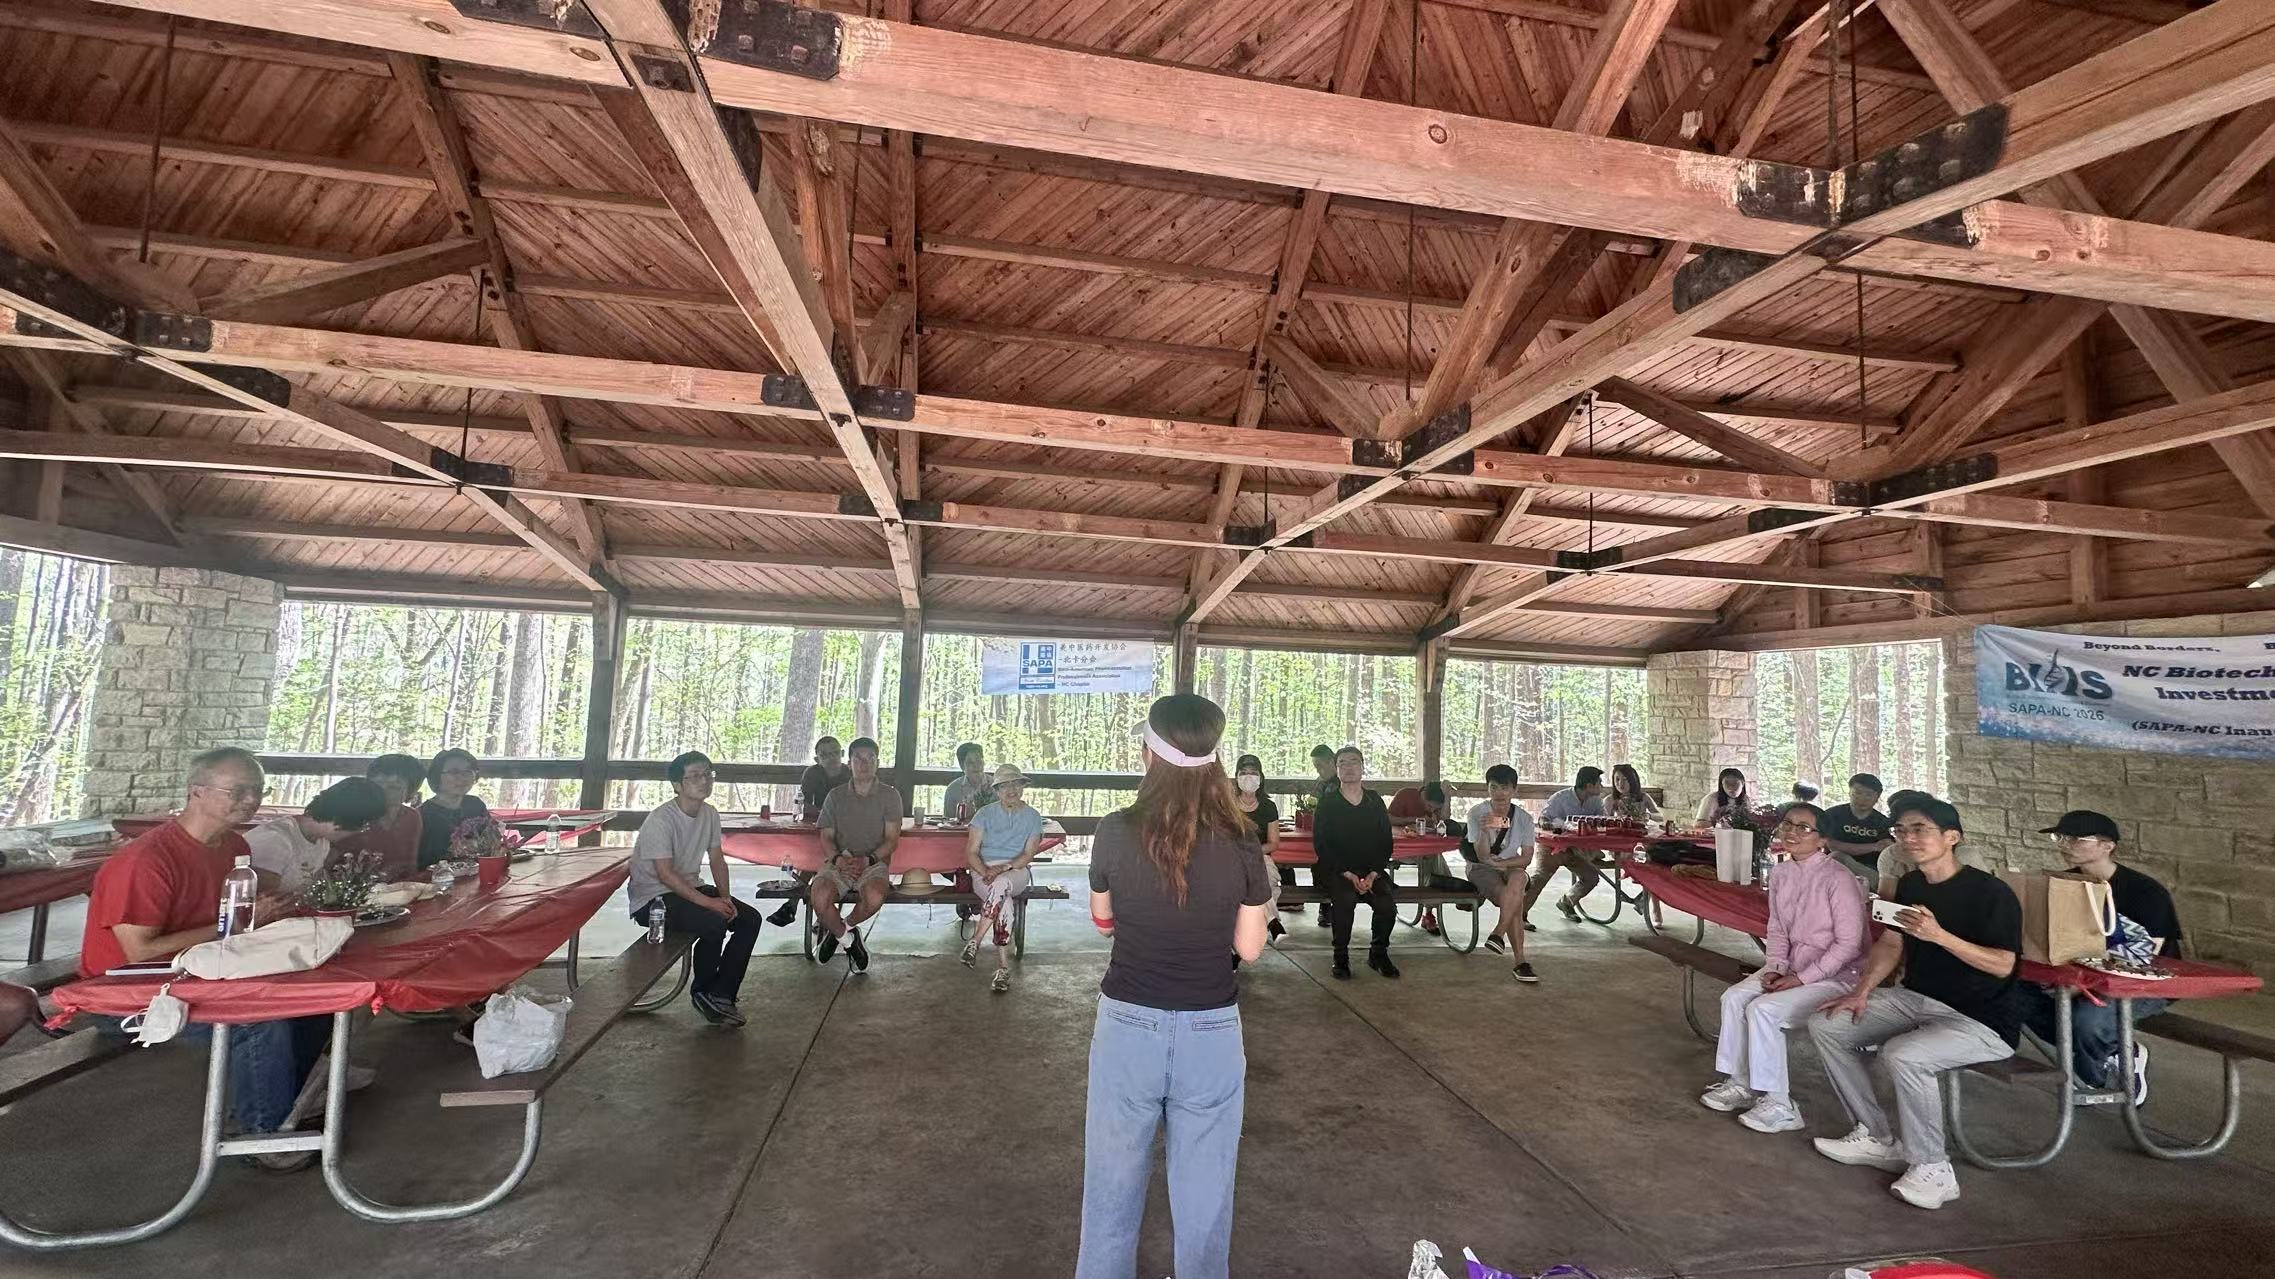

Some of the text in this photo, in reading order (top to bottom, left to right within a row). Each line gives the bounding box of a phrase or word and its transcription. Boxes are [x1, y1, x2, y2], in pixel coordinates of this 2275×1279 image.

[2083, 641, 2142, 652] Beyond
[1022, 659, 1053, 668] SAPA
[2121, 665, 2162, 678] NC
[2008, 702, 2071, 718] SAPA-NC
[2073, 707, 2106, 721] 2026
[2131, 720, 2275, 736] (SAPA-NC Inau
